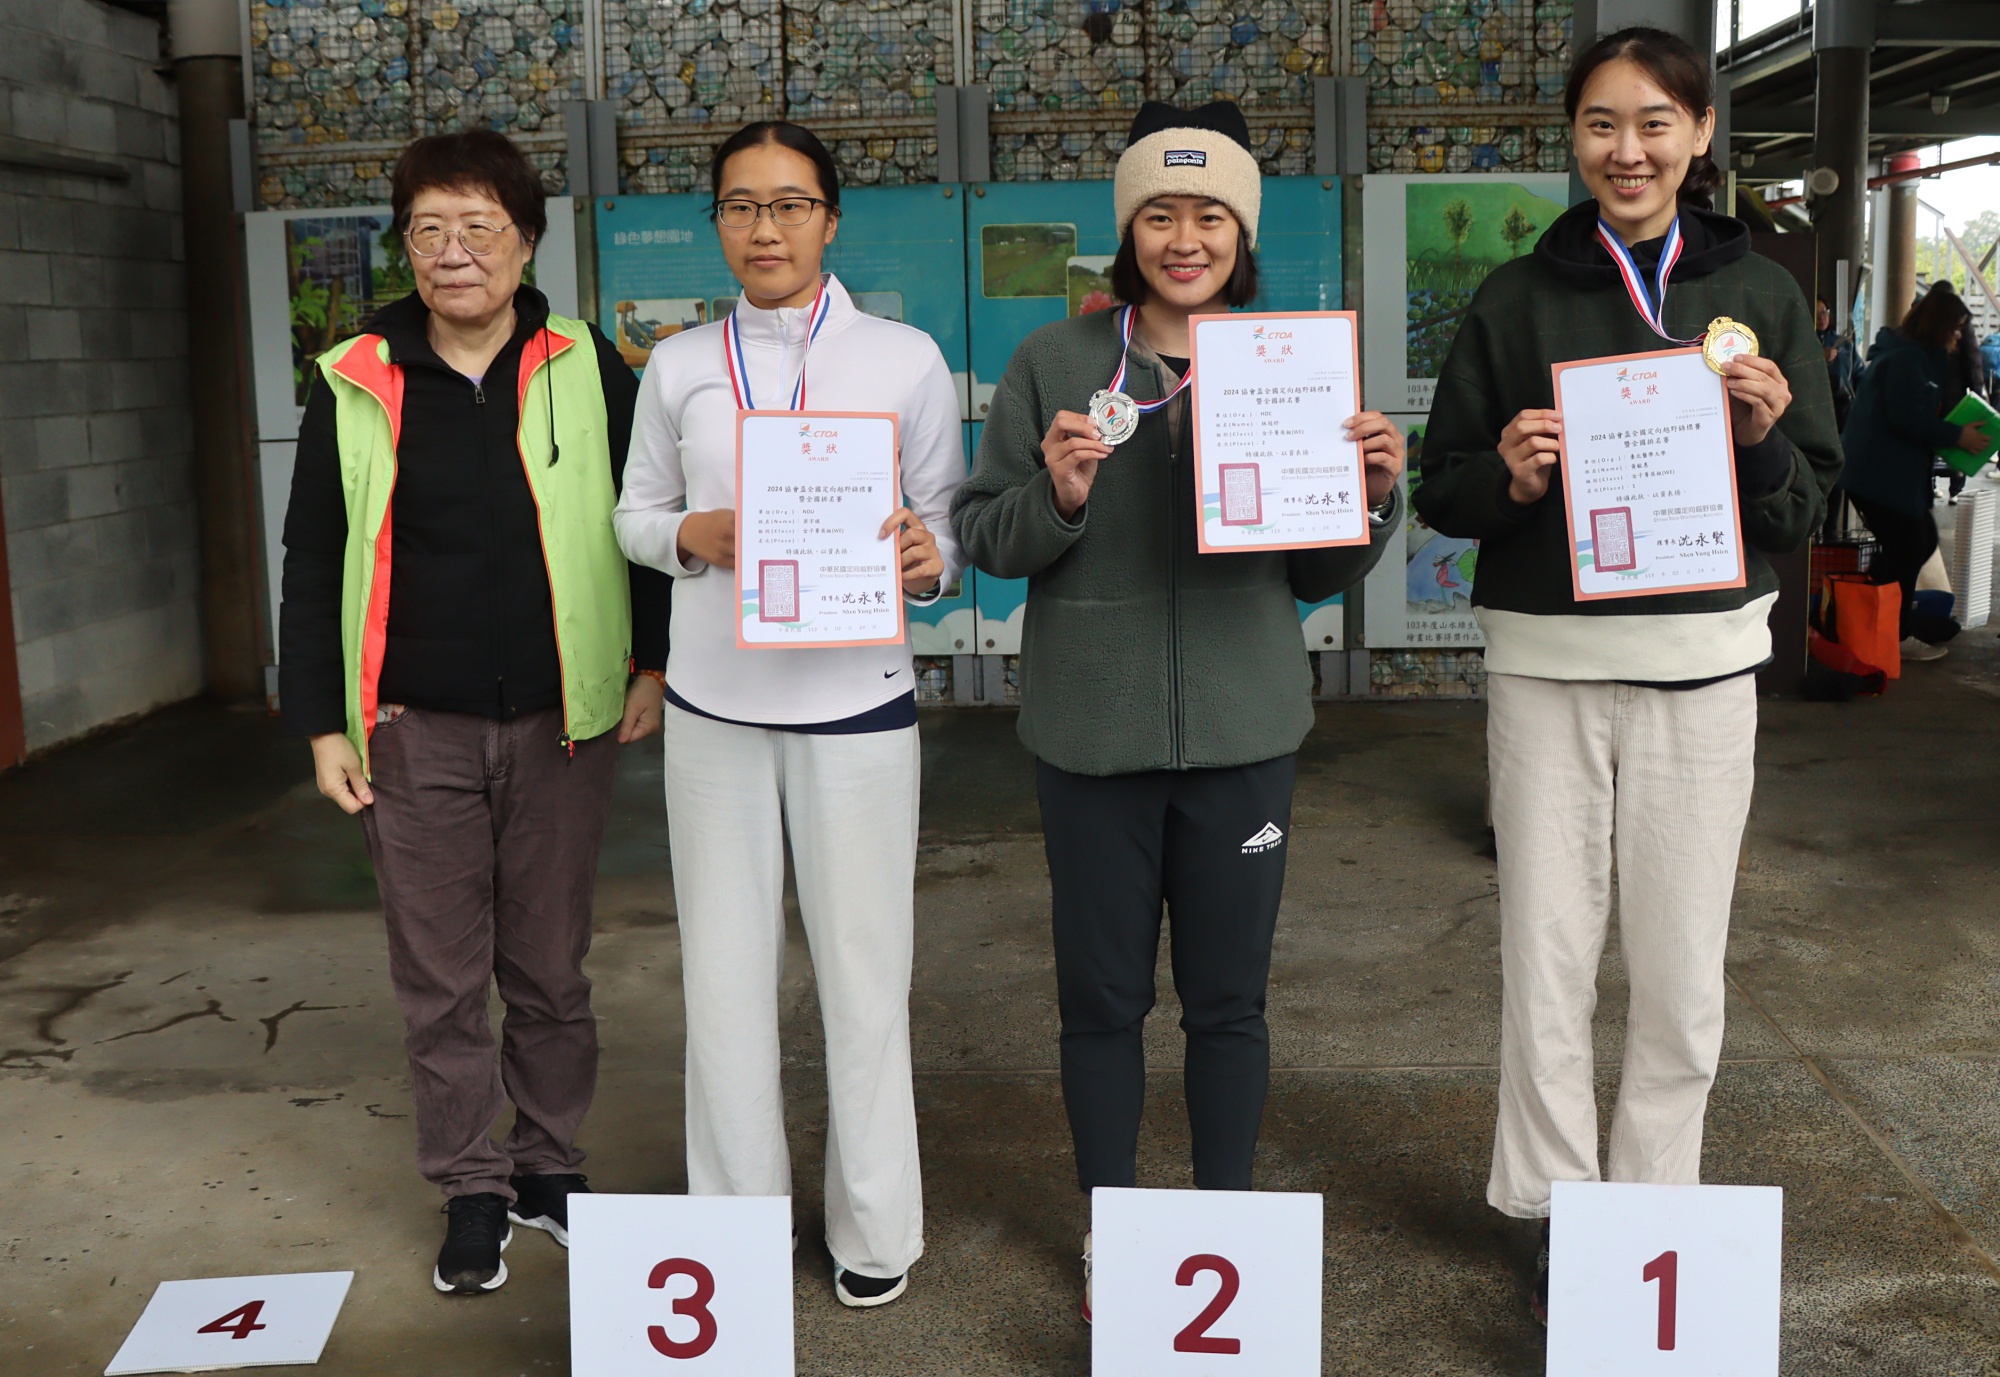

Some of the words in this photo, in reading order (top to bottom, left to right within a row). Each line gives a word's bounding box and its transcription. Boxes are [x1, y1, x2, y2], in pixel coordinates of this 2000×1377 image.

[1632, 371, 1657, 380] CTOA
[814, 430, 838, 438] CTOA
[1407, 621, 1479, 629] 103年度山水綠生
[1406, 633, 1480, 642] 繪畫比賽得獎作品
[1242, 846, 1264, 854] NIKE
[1173, 1253, 1241, 1355] 2
[1642, 1250, 1678, 1351] 1
[647, 1257, 718, 1360] 3
[197, 1300, 266, 1340] 4
